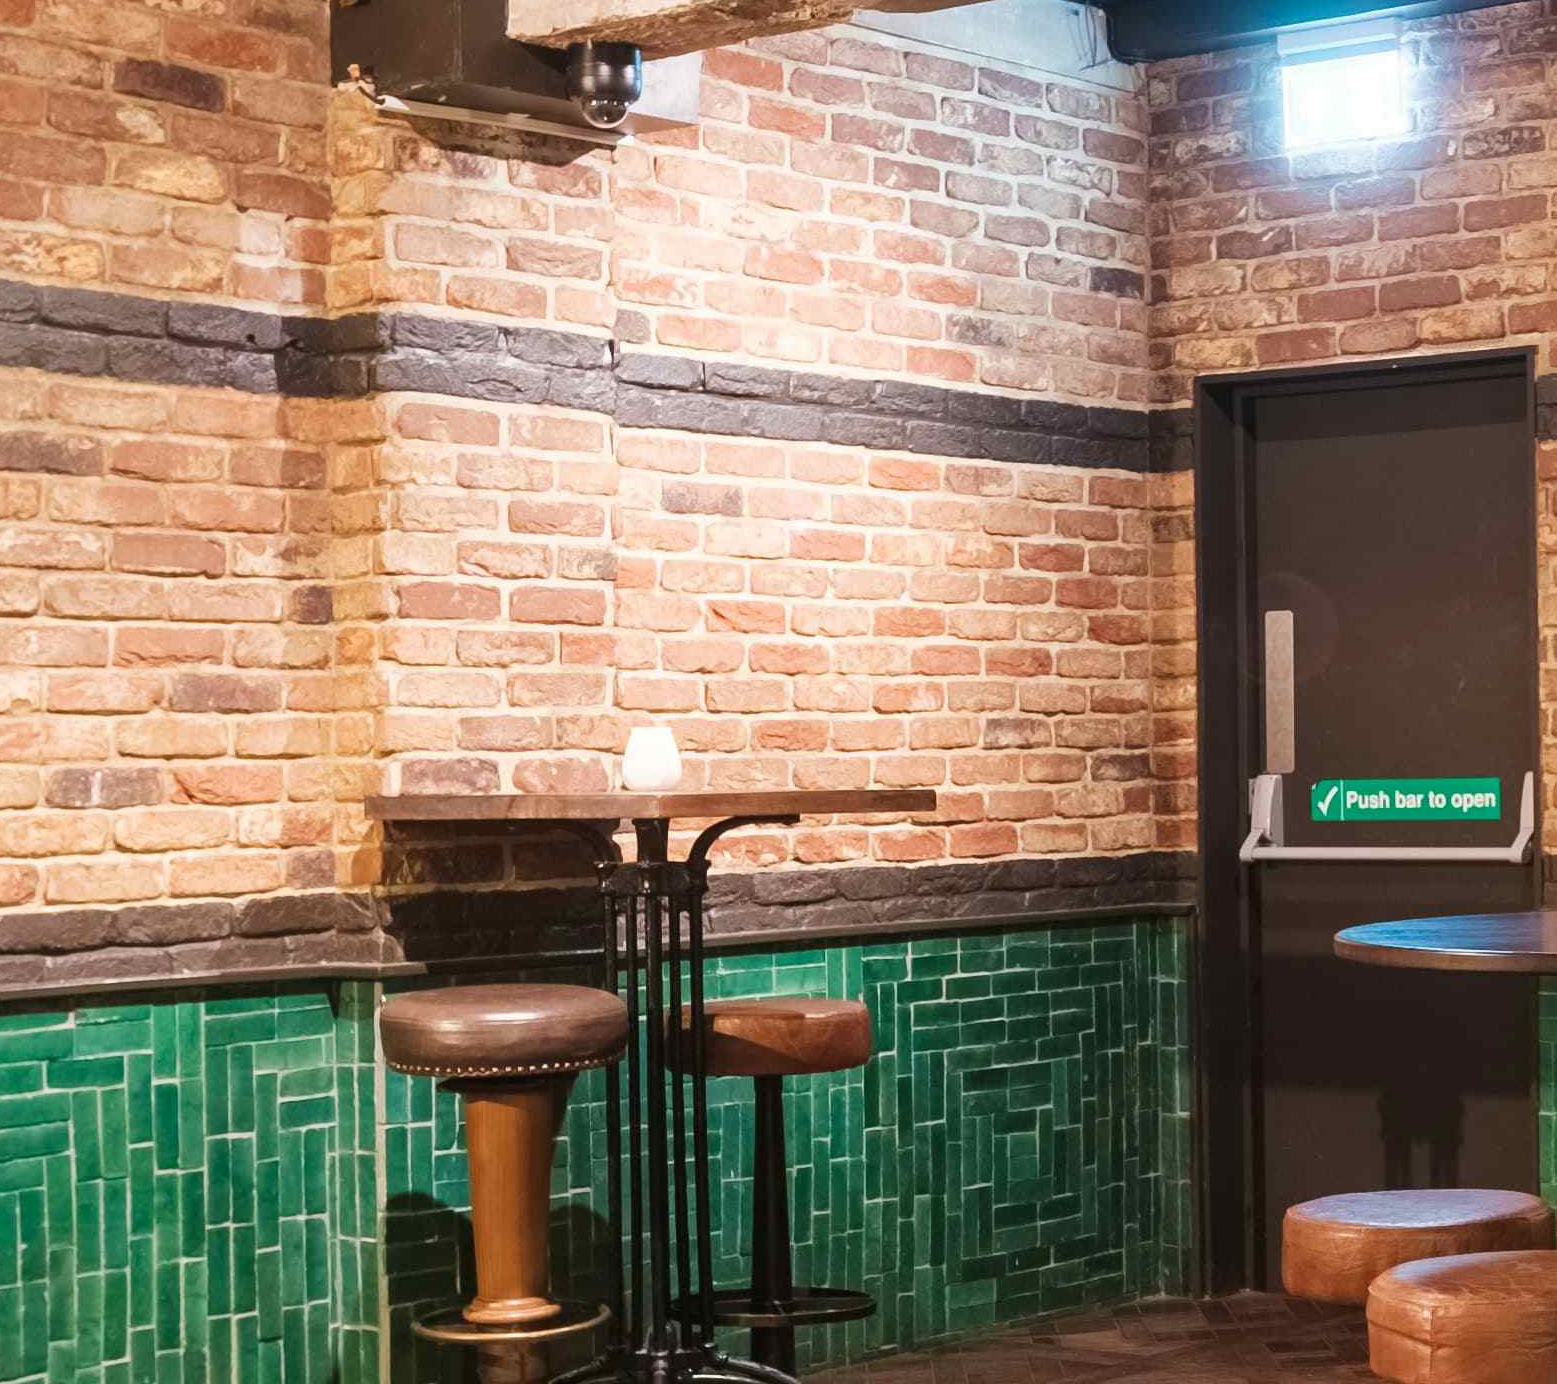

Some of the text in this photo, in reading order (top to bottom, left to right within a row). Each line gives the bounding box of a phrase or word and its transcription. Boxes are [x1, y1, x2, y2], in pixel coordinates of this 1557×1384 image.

[1346, 790, 1497, 813] Push bar to open
